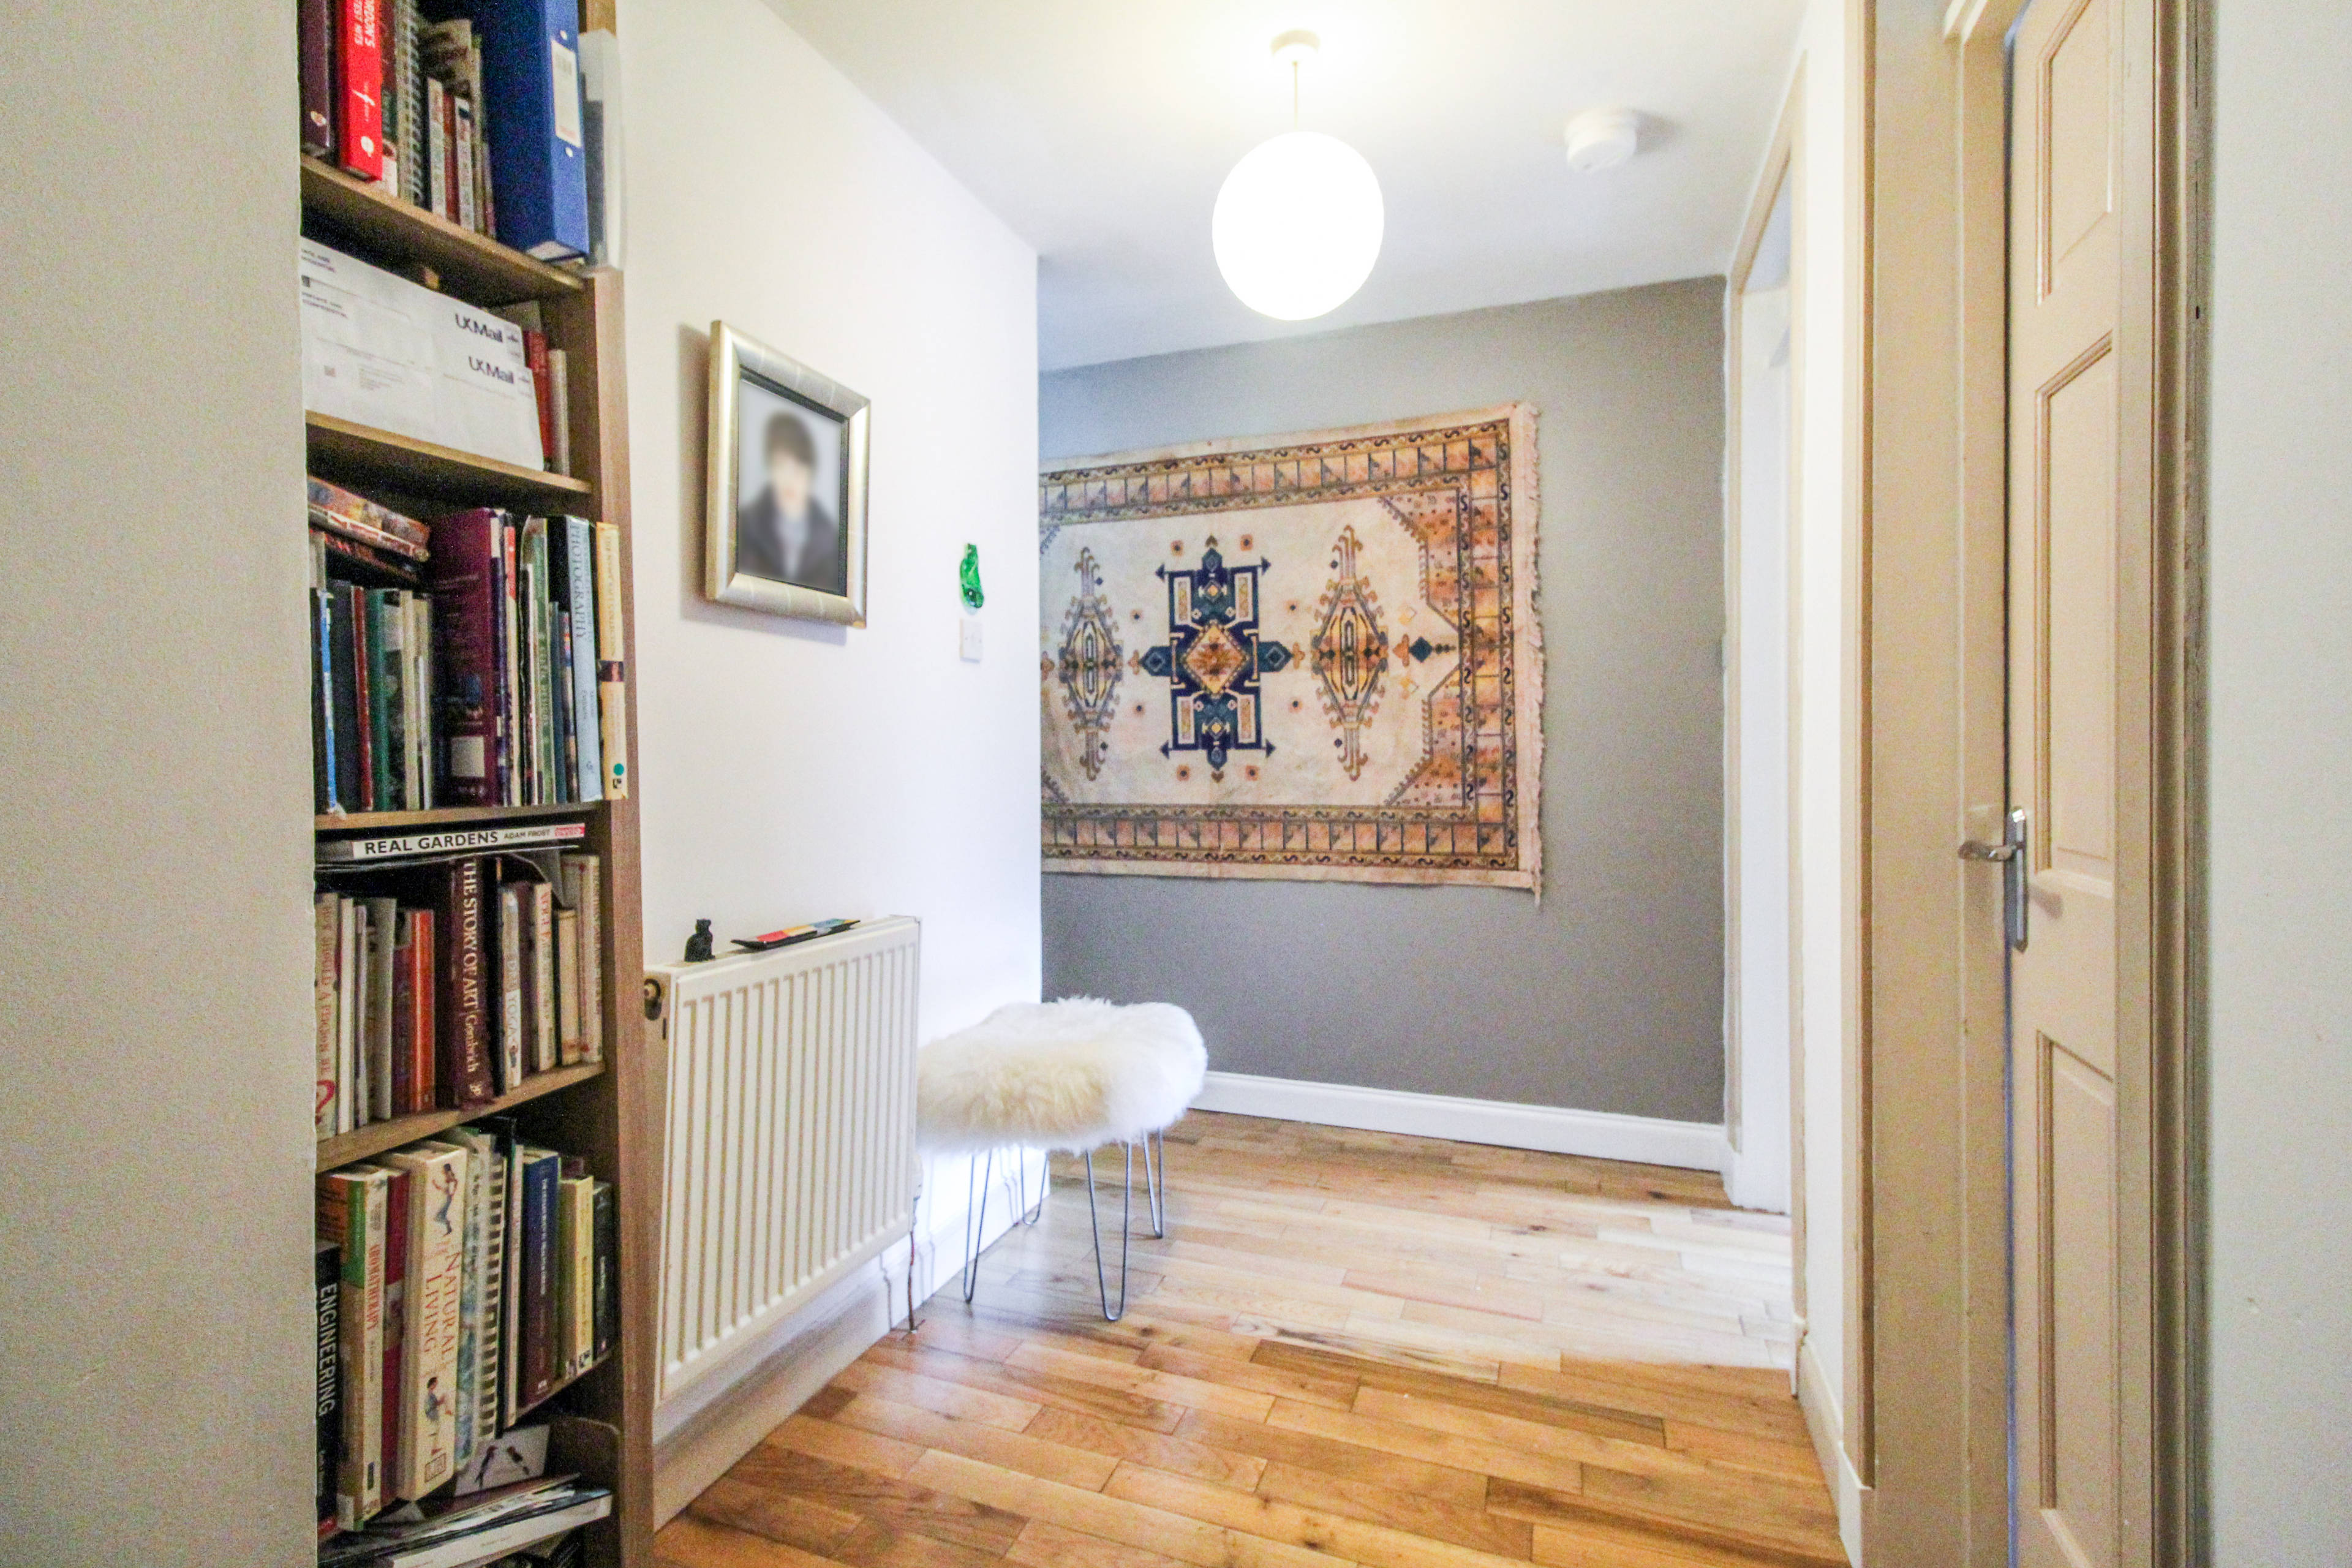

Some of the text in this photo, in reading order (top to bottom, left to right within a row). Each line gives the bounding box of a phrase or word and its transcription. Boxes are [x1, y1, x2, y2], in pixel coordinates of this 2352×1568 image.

[455, 313, 503, 343] UKMail
[469, 355, 514, 385] UKMail
[569, 525, 586, 639] PHOTOGRAPHY
[364, 839, 412, 855] REAL
[418, 831, 499, 850] GARDENS
[503, 831, 526, 840] ADAM
[527, 828, 551, 838] FROST
[320, 937, 333, 986] SHOULD
[462, 861, 480, 1074] THE STORY OF ART Gombrich
[320, 1004, 333, 1053] PERSON
[507, 993, 519, 1038] YOGA
[321, 1057, 332, 1075] BE
[366, 1243, 381, 1332] AROMATHERAPY
[442, 1251, 462, 1360] NATURAL
[426, 1274, 442, 1355] LIVING
[318, 1283, 337, 1417] ENGINEERING
